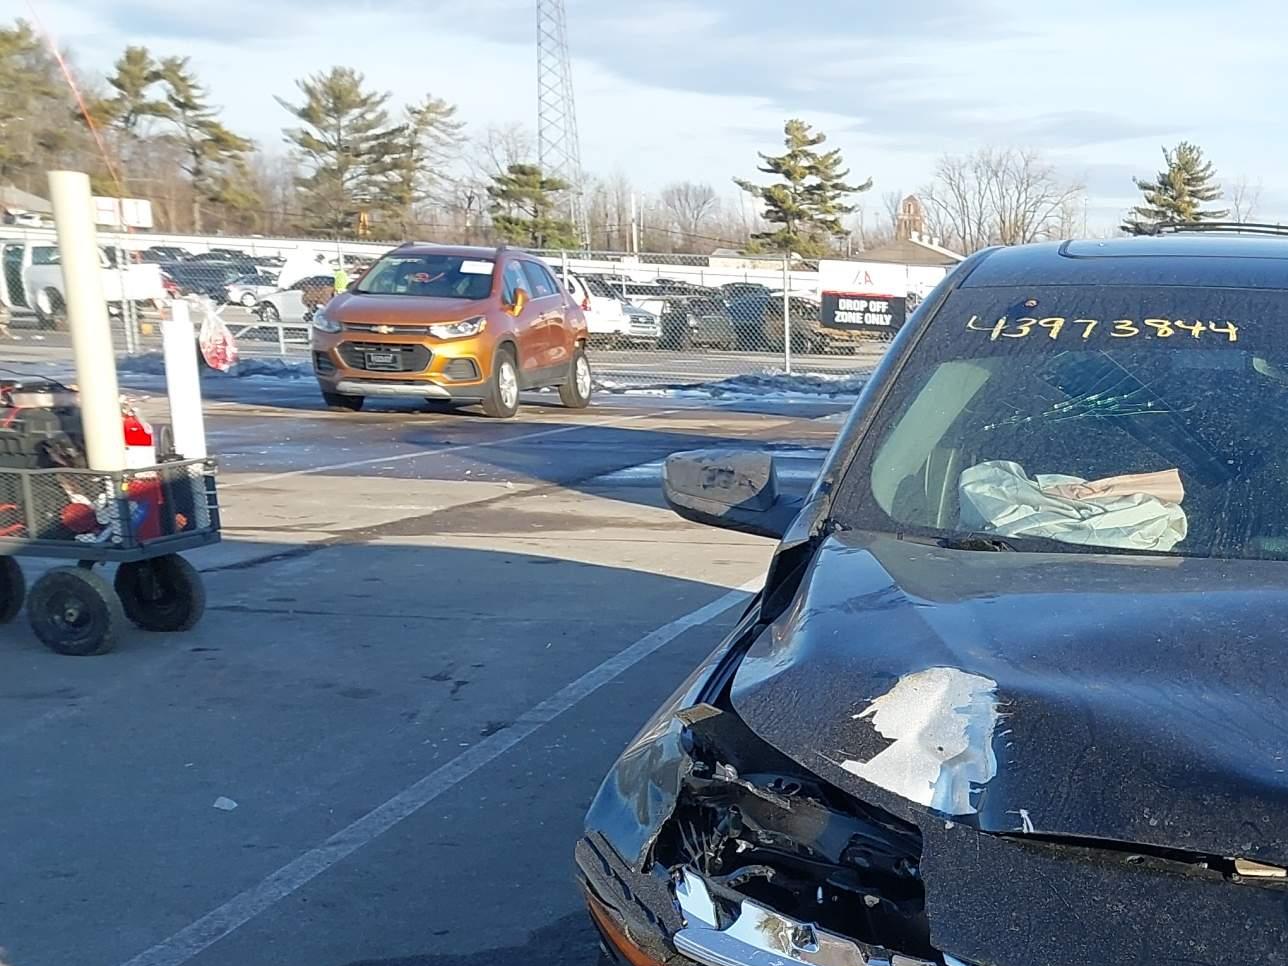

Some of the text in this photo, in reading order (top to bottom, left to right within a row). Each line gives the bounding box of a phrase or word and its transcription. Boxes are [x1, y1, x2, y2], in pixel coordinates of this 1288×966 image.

[839, 298, 889, 313] DROP OFF
[834, 310, 892, 326] ZONE ONLY
[966, 315, 1238, 341] 43973844
